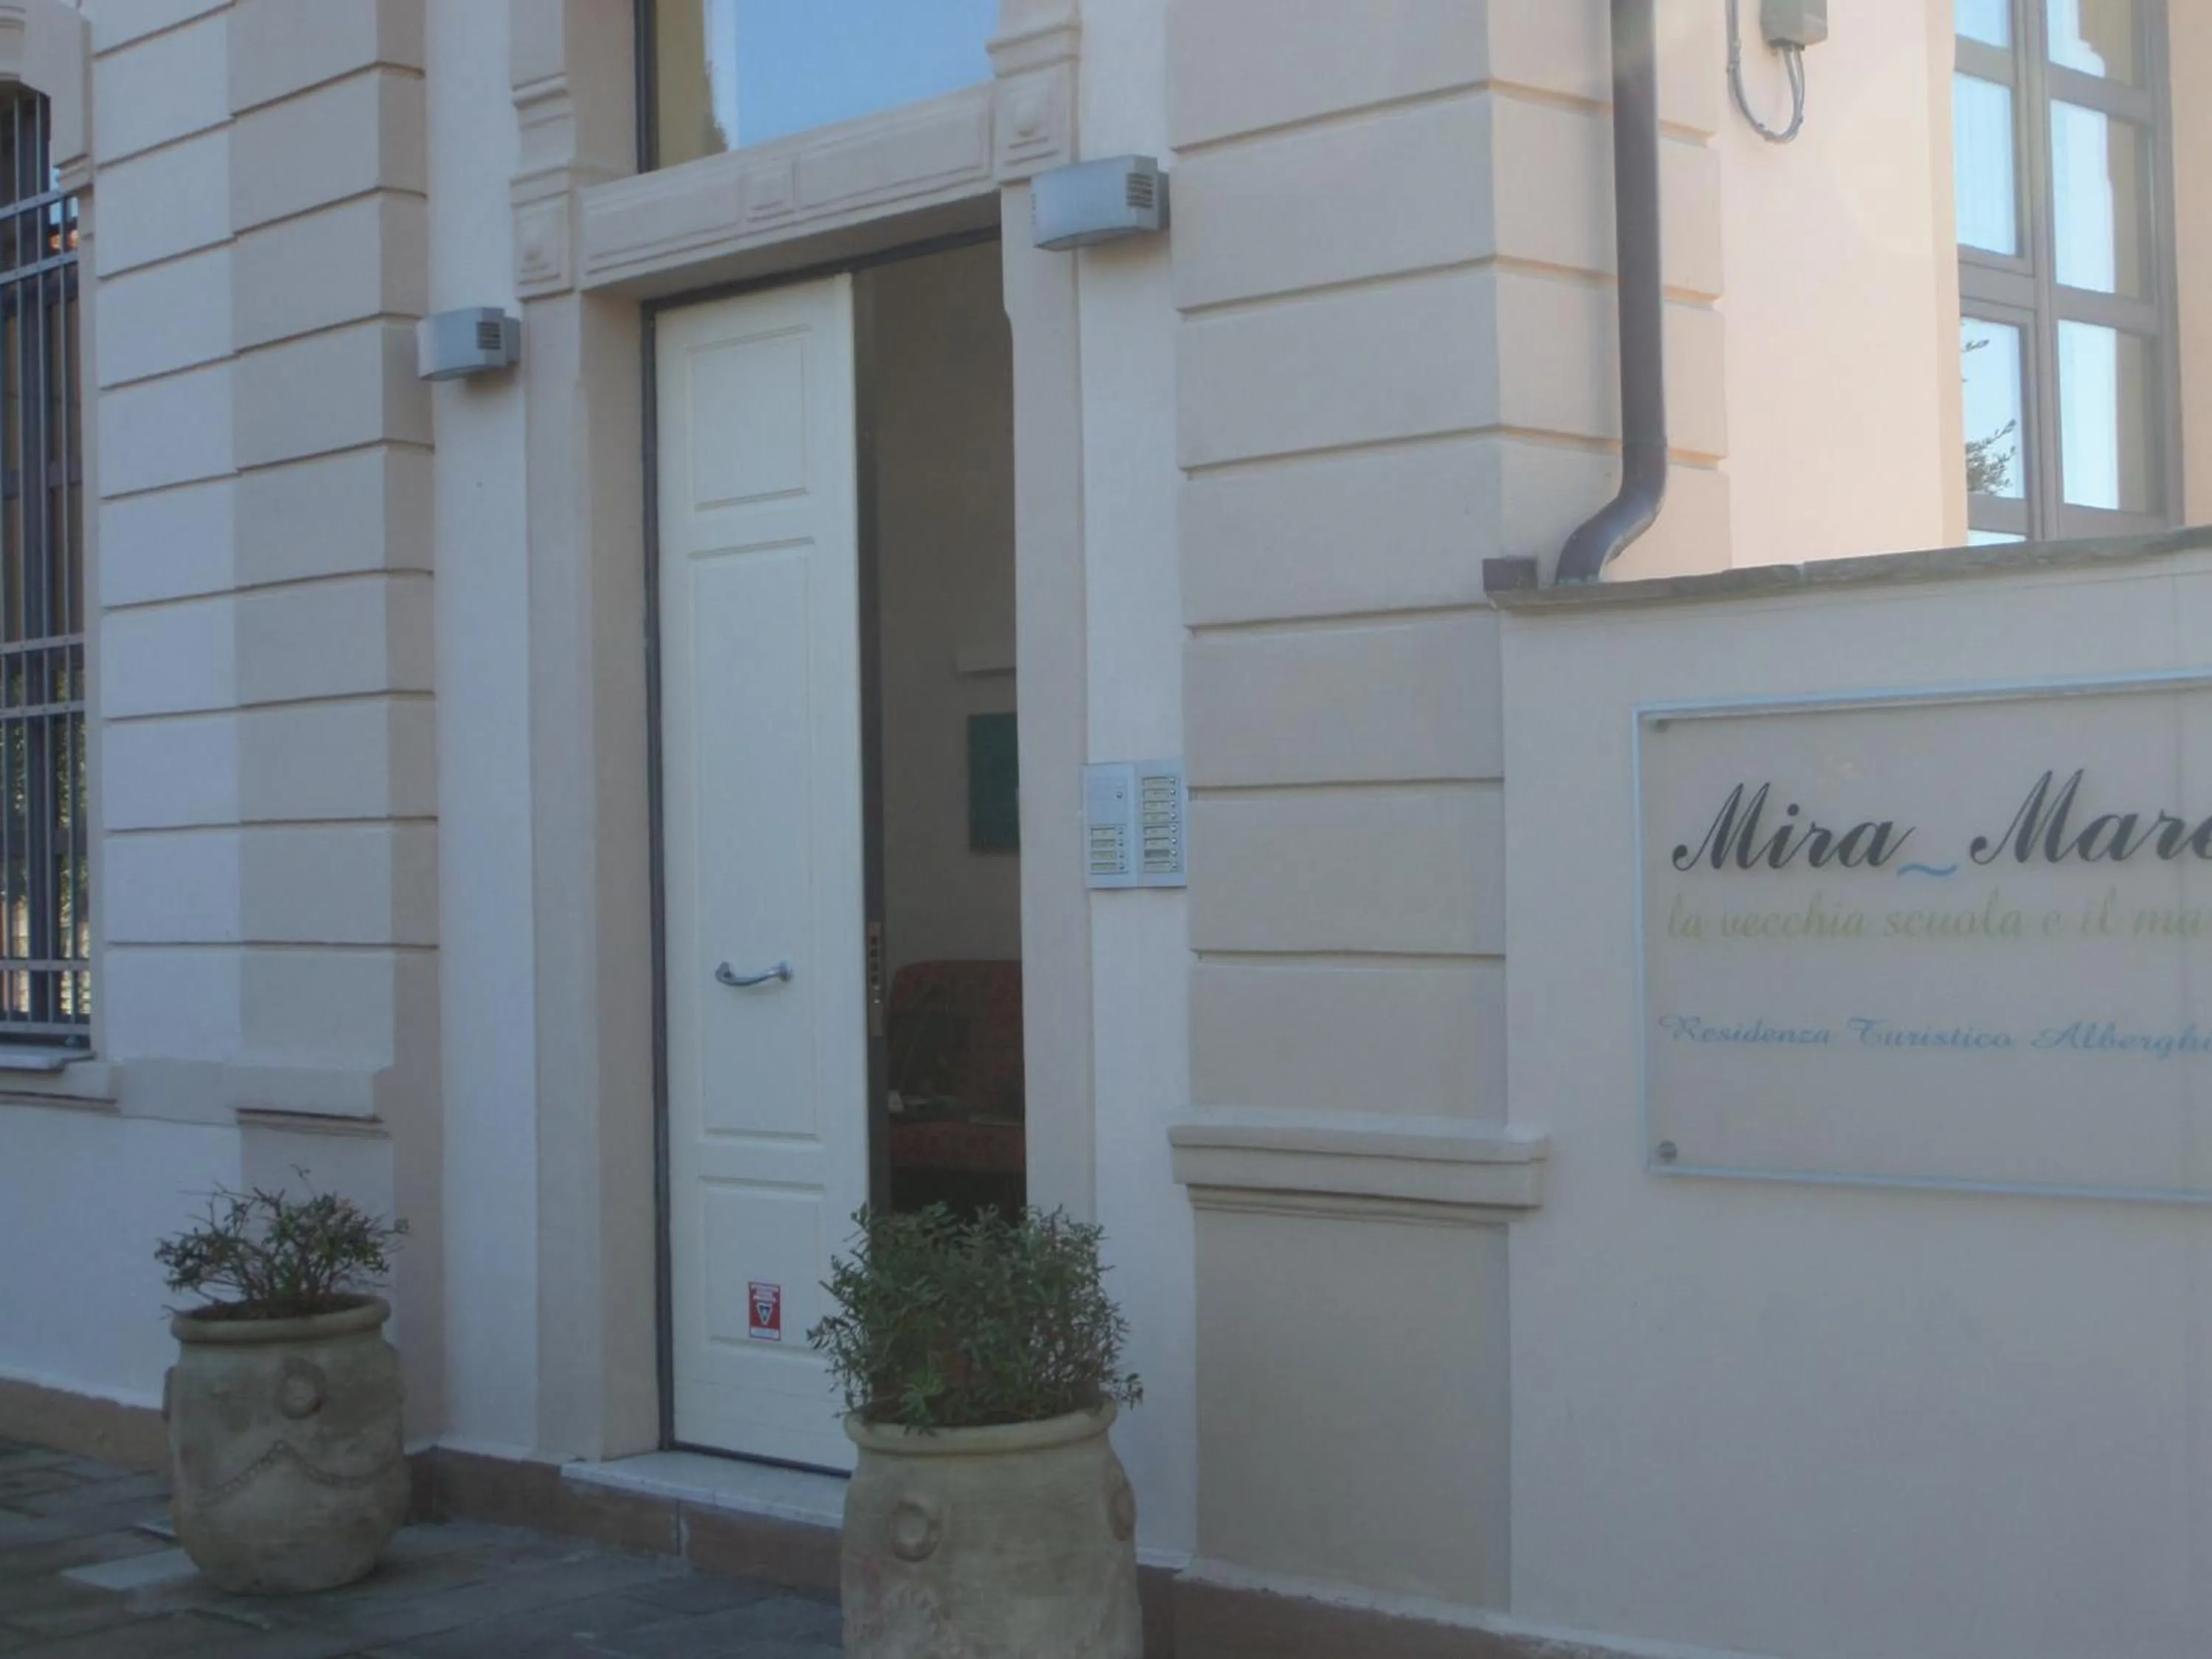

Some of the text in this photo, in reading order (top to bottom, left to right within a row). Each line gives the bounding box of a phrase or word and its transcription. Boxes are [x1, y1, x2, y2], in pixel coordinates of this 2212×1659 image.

[1672, 782, 1916, 872] Mira
[1666, 891, 1703, 939] la
[1721, 888, 1865, 939] vecchia
[1882, 886, 2023, 938] scuola
[2042, 909, 2062, 937] e
[2079, 886, 2118, 937] il
[1659, 1014, 1831, 1047] Residenza
